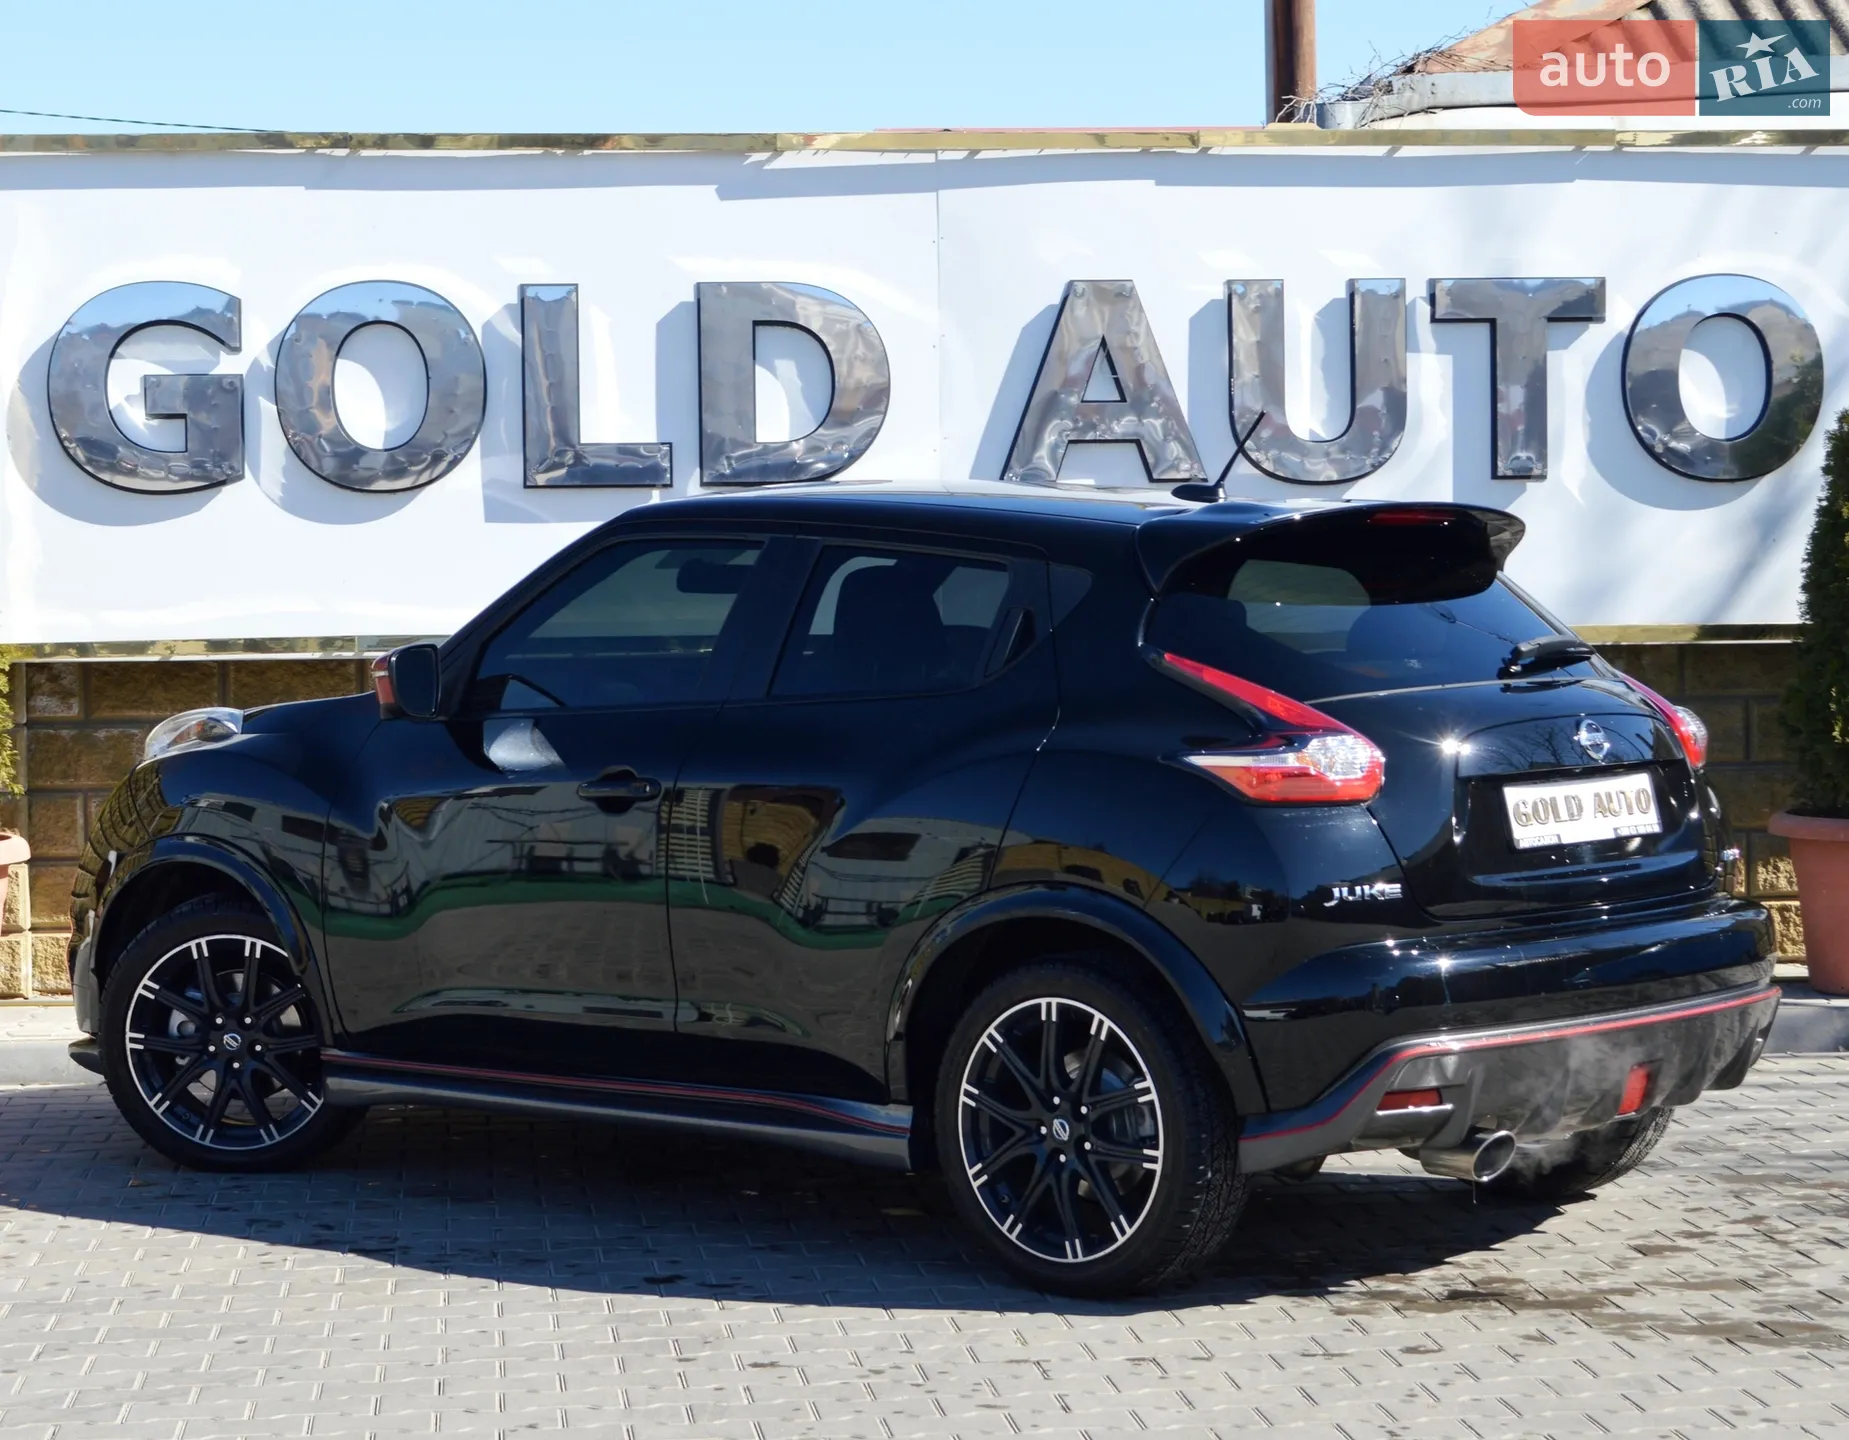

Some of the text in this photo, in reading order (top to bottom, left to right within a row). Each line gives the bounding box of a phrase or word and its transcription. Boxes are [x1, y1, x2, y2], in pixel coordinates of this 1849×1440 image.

[47, 273, 1825, 494] GOLD AUTO
[1512, 787, 1651, 827] GOLD AUTO
[1323, 882, 1402, 907] JUKE
